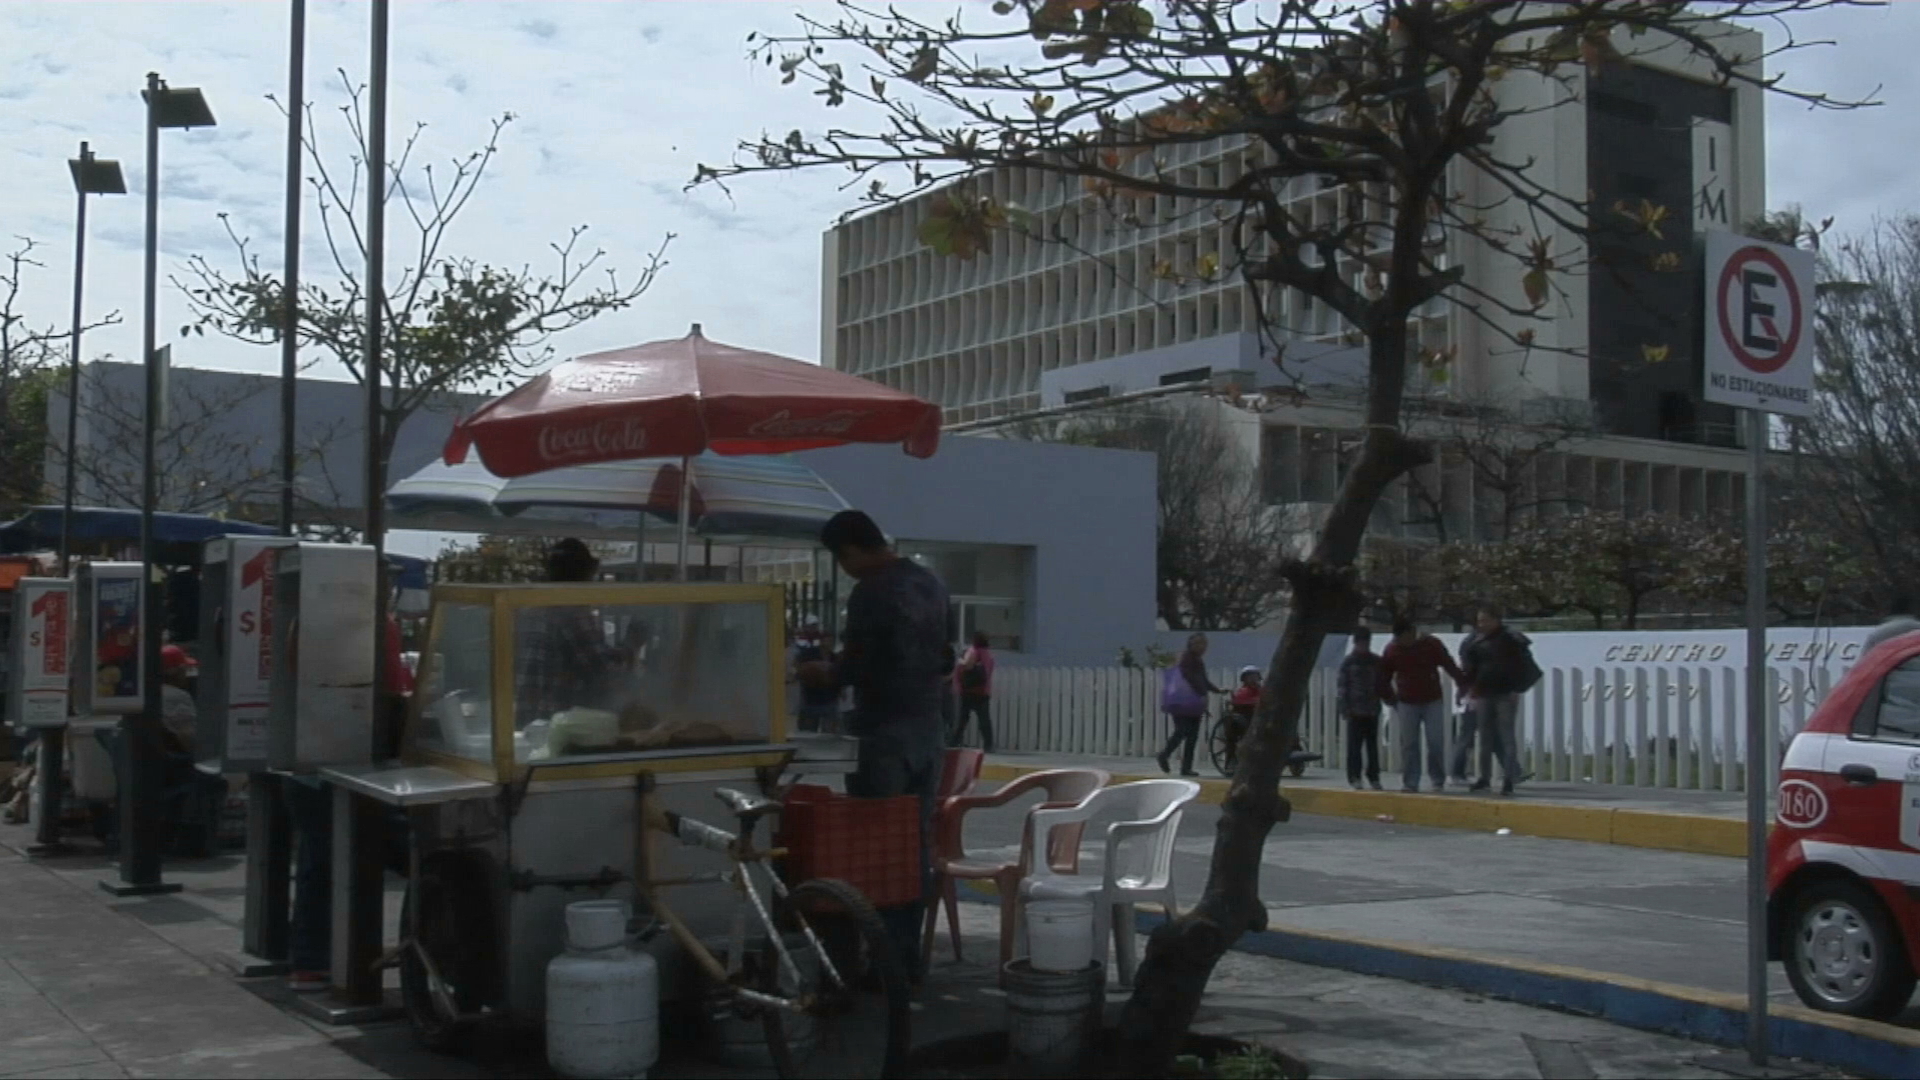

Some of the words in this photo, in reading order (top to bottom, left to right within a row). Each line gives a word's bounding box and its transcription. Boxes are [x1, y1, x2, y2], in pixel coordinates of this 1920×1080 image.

[1743, 268, 1778, 351] E
[1710, 371, 1726, 389] NO
[1728, 375, 1809, 404] ESTACIONARSE
[1604, 643, 1728, 662] CENTRO
[1765, 641, 1861, 662] EDIC
